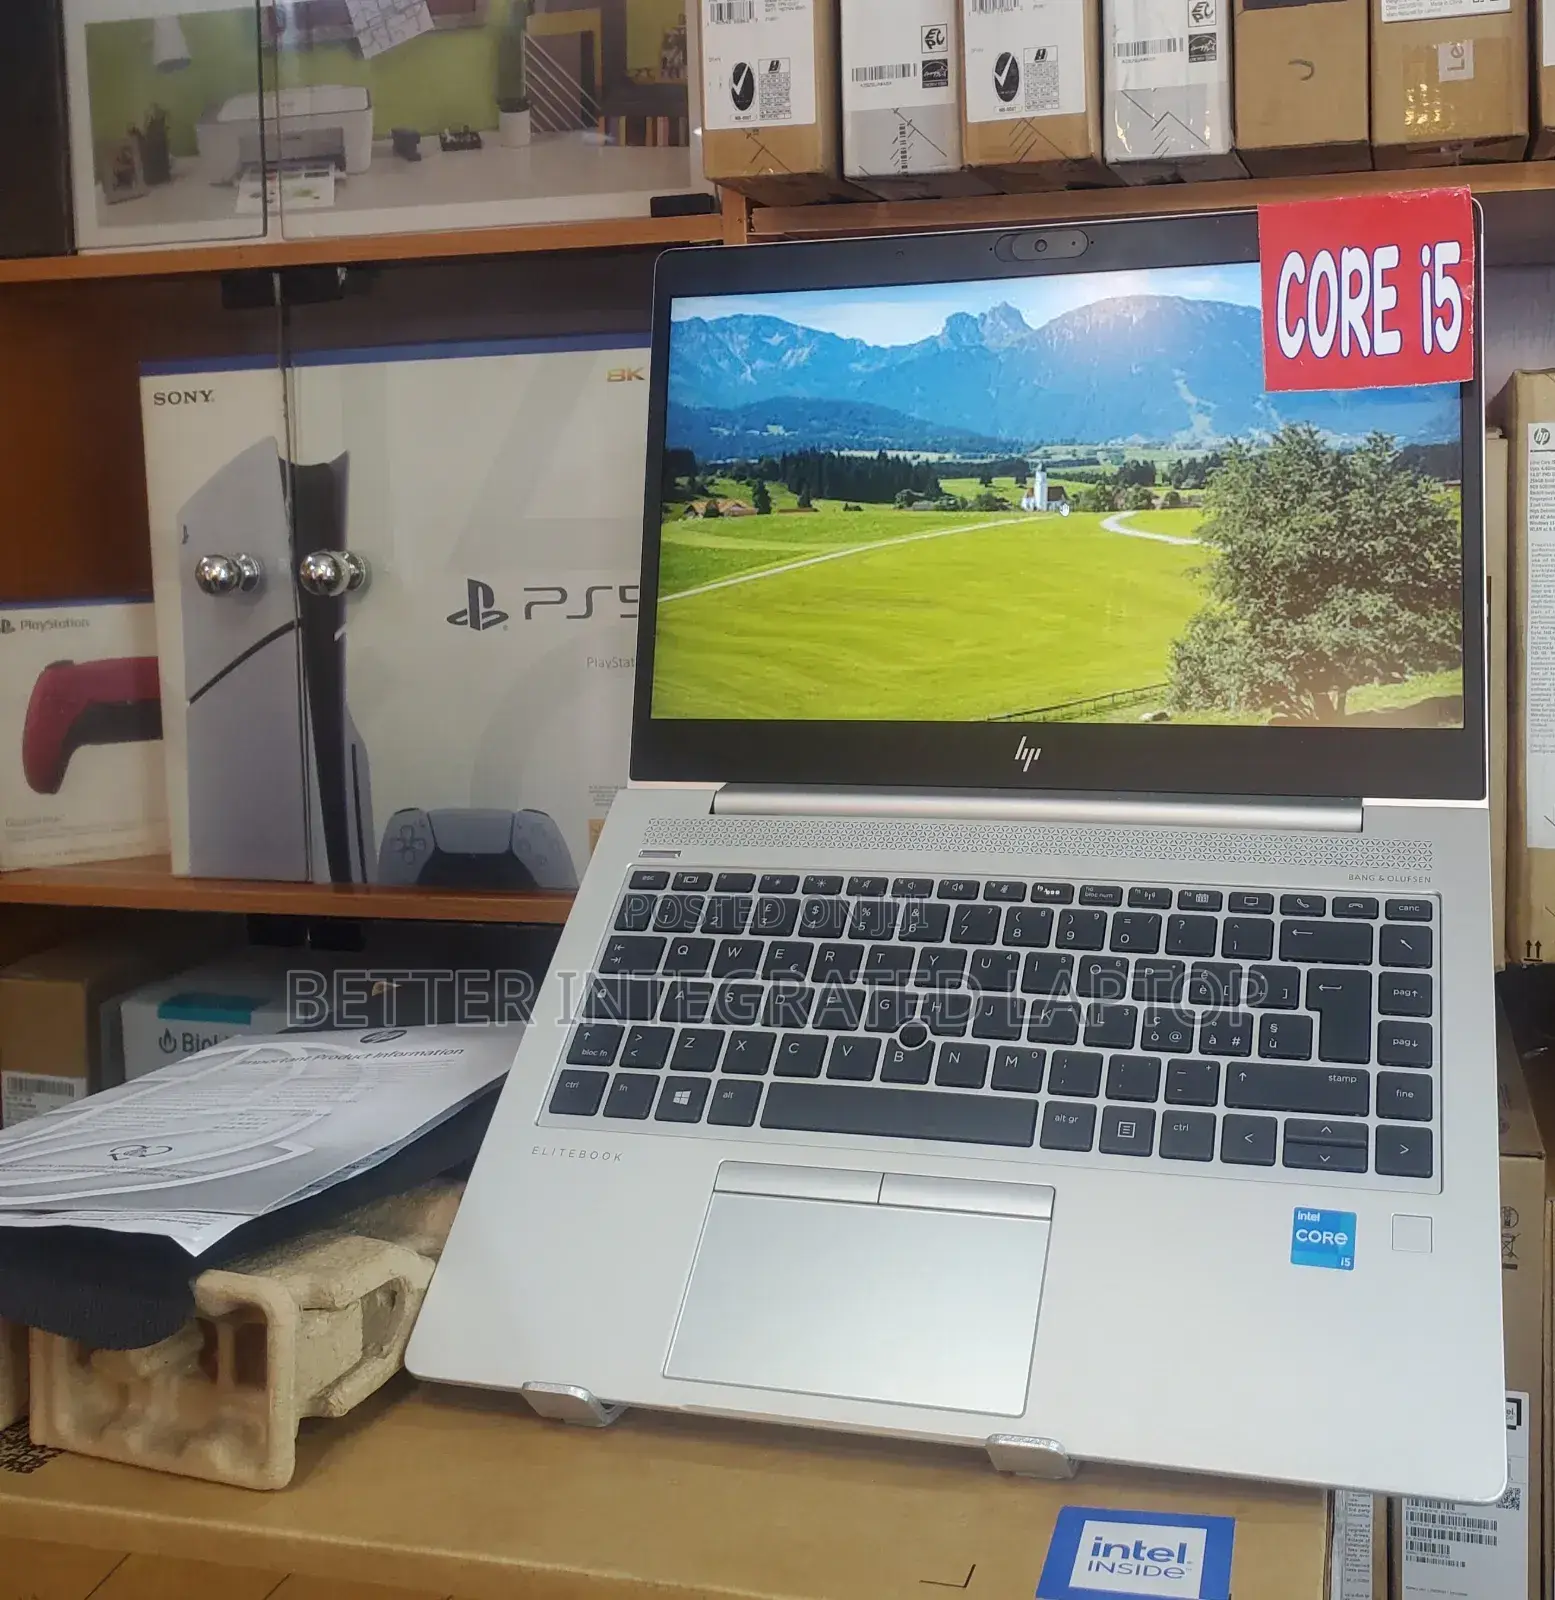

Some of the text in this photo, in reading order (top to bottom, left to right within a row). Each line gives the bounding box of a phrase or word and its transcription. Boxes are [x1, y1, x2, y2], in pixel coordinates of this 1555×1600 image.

[1276, 240, 1463, 359] CORE i5
[607, 367, 645, 382] 8K
[154, 390, 213, 406] SONY
[20, 618, 90, 631] PlayStation
[587, 656, 634, 668] PlayStat
[1014, 736, 1042, 772] hp
[1348, 874, 1375, 882] BANG
[812, 906, 819, 915] $
[862, 908, 871, 917] %
[911, 909, 919, 917] &
[663, 915, 668, 923] 1
[711, 917, 719, 925] 2
[1015, 912, 1021, 922] (
[1068, 914, 1074, 925] )
[858, 922, 866, 931] 5
[909, 924, 916, 932] 6
[1179, 920, 1185, 929] ?
[961, 926, 968, 935] 7
[1013, 928, 1022, 938] 8
[1066, 931, 1075, 940] 9
[678, 945, 688, 955] Q
[728, 947, 742, 957] W
[775, 949, 785, 959] E
[825, 951, 835, 961] R
[877, 954, 885, 963] T
[929, 955, 939, 965] Y
[790, 963, 798, 972] €
[981, 958, 992, 968] U
[1090, 964, 1101, 975] O
[1144, 968, 1154, 978] P
[675, 990, 685, 1000] A
[724, 992, 734, 1002] S
[1393, 988, 1410, 997] pag
[775, 995, 785, 1004] D
[826, 996, 836, 1007] F
[880, 999, 890, 1009] G
[932, 1002, 942, 1012] H
[985, 1005, 993, 1016] J
[1041, 1010, 1051, 1020] K
[1097, 1013, 1105, 1023] L
[1169, 1031, 1182, 1042] @
[1209, 1035, 1241, 1046] à #
[684, 1038, 696, 1048] Z
[735, 1040, 747, 1050] X
[1393, 1038, 1410, 1046] pag
[789, 1043, 799, 1054] C
[843, 1046, 853, 1056] V
[371, 1048, 464, 1060] Information
[894, 1051, 904, 1062] B
[949, 1052, 960, 1063] N
[1005, 1056, 1018, 1068] M
[1328, 1074, 1356, 1083] stamp
[1396, 1089, 1414, 1098] fine
[1054, 1114, 1079, 1124] alt gr
[1174, 1124, 1189, 1132] ctrl
[532, 1146, 623, 1162] ELITEBOOK
[1297, 1210, 1320, 1222] intel
[1340, 1257, 1350, 1267] i5
[1091, 1536, 1187, 1564] intel
